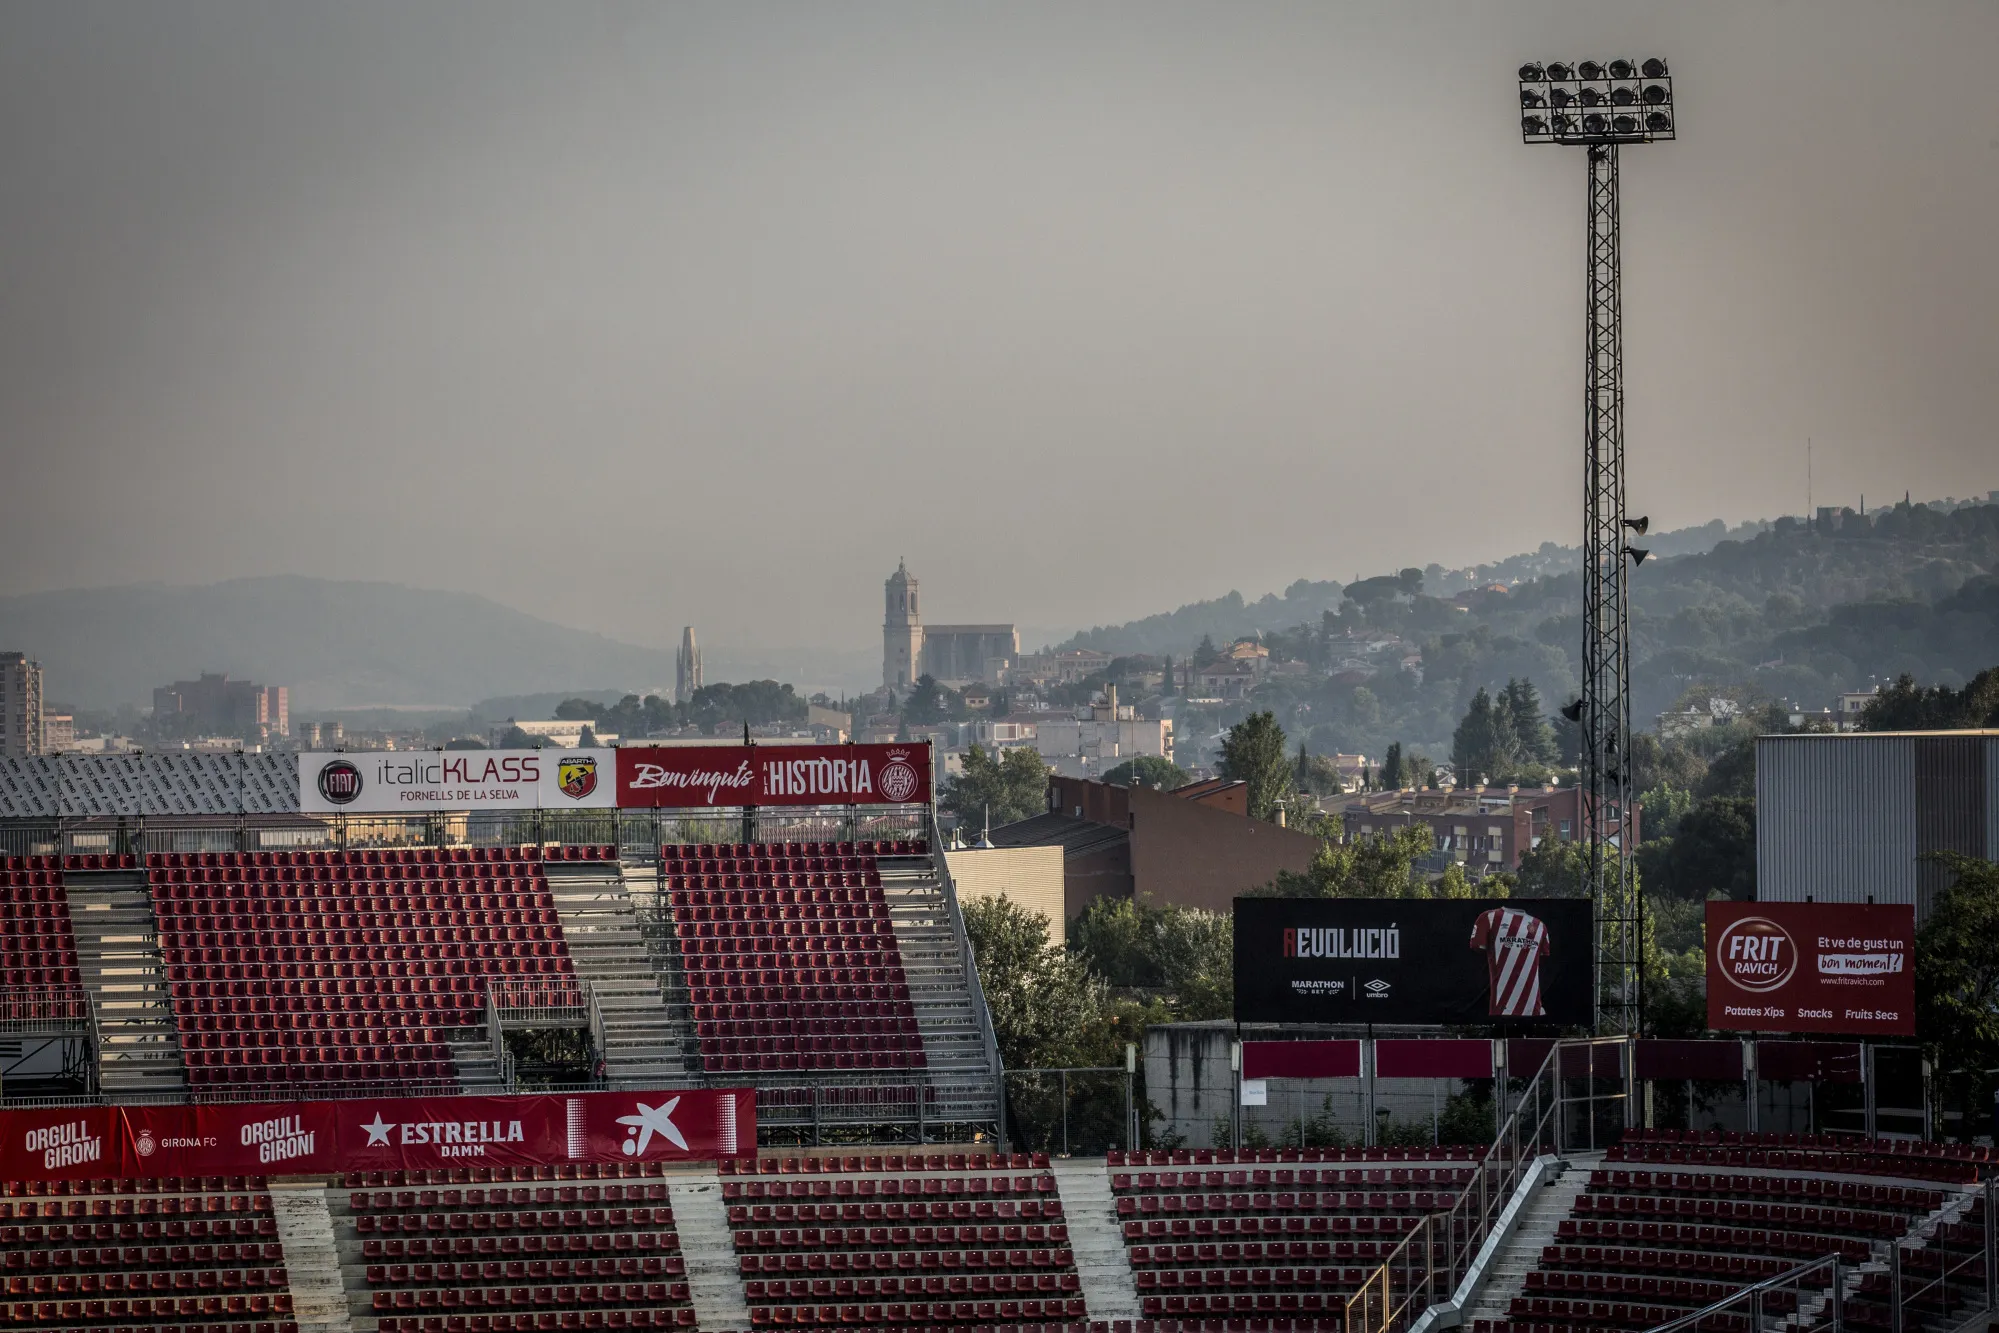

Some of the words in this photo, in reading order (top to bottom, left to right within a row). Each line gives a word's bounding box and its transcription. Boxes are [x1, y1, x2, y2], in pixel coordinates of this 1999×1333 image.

[378, 757, 539, 784] italicKLASS
[763, 762, 768, 772] A
[329, 773, 354, 793] FIAT
[629, 760, 755, 804] Benvinguts
[400, 791, 453, 801] FORNELLS
[457, 790, 470, 800] DE
[474, 790, 487, 800] LA
[490, 789, 519, 800] SELVA
[1283, 922, 1400, 958] REVOLUCIÓ
[1818, 937, 1829, 948] Et
[1832, 939, 1845, 948] ve
[1847, 937, 1860, 949] de
[1863, 938, 1888, 951] gust
[1889, 940, 1903, 949] un
[1729, 936, 1785, 961] FRIT
[1734, 962, 1778, 975] RAVICH
[1821, 955, 1840, 969] bon
[1291, 980, 1344, 989] MARATHON
[1820, 976, 1884, 986] www.fritravich.com
[1725, 1005, 1761, 1016] Patates
[1763, 1006, 1785, 1018] Xips
[1797, 1008, 1833, 1018] Snacks
[1845, 1009, 1873, 1020] Fruits
[1875, 1010, 1898, 1020] Secs
[26, 1120, 91, 1152] ORGULL
[241, 1115, 305, 1146] ORGULL
[401, 1120, 524, 1145] ESTRELLA
[161, 1138, 201, 1147] GIRONA
[203, 1137, 217, 1147] FC
[260, 1130, 315, 1163] GIRONÍ
[45, 1136, 101, 1170] GIRONÍ
[441, 1144, 485, 1157] DAMM
